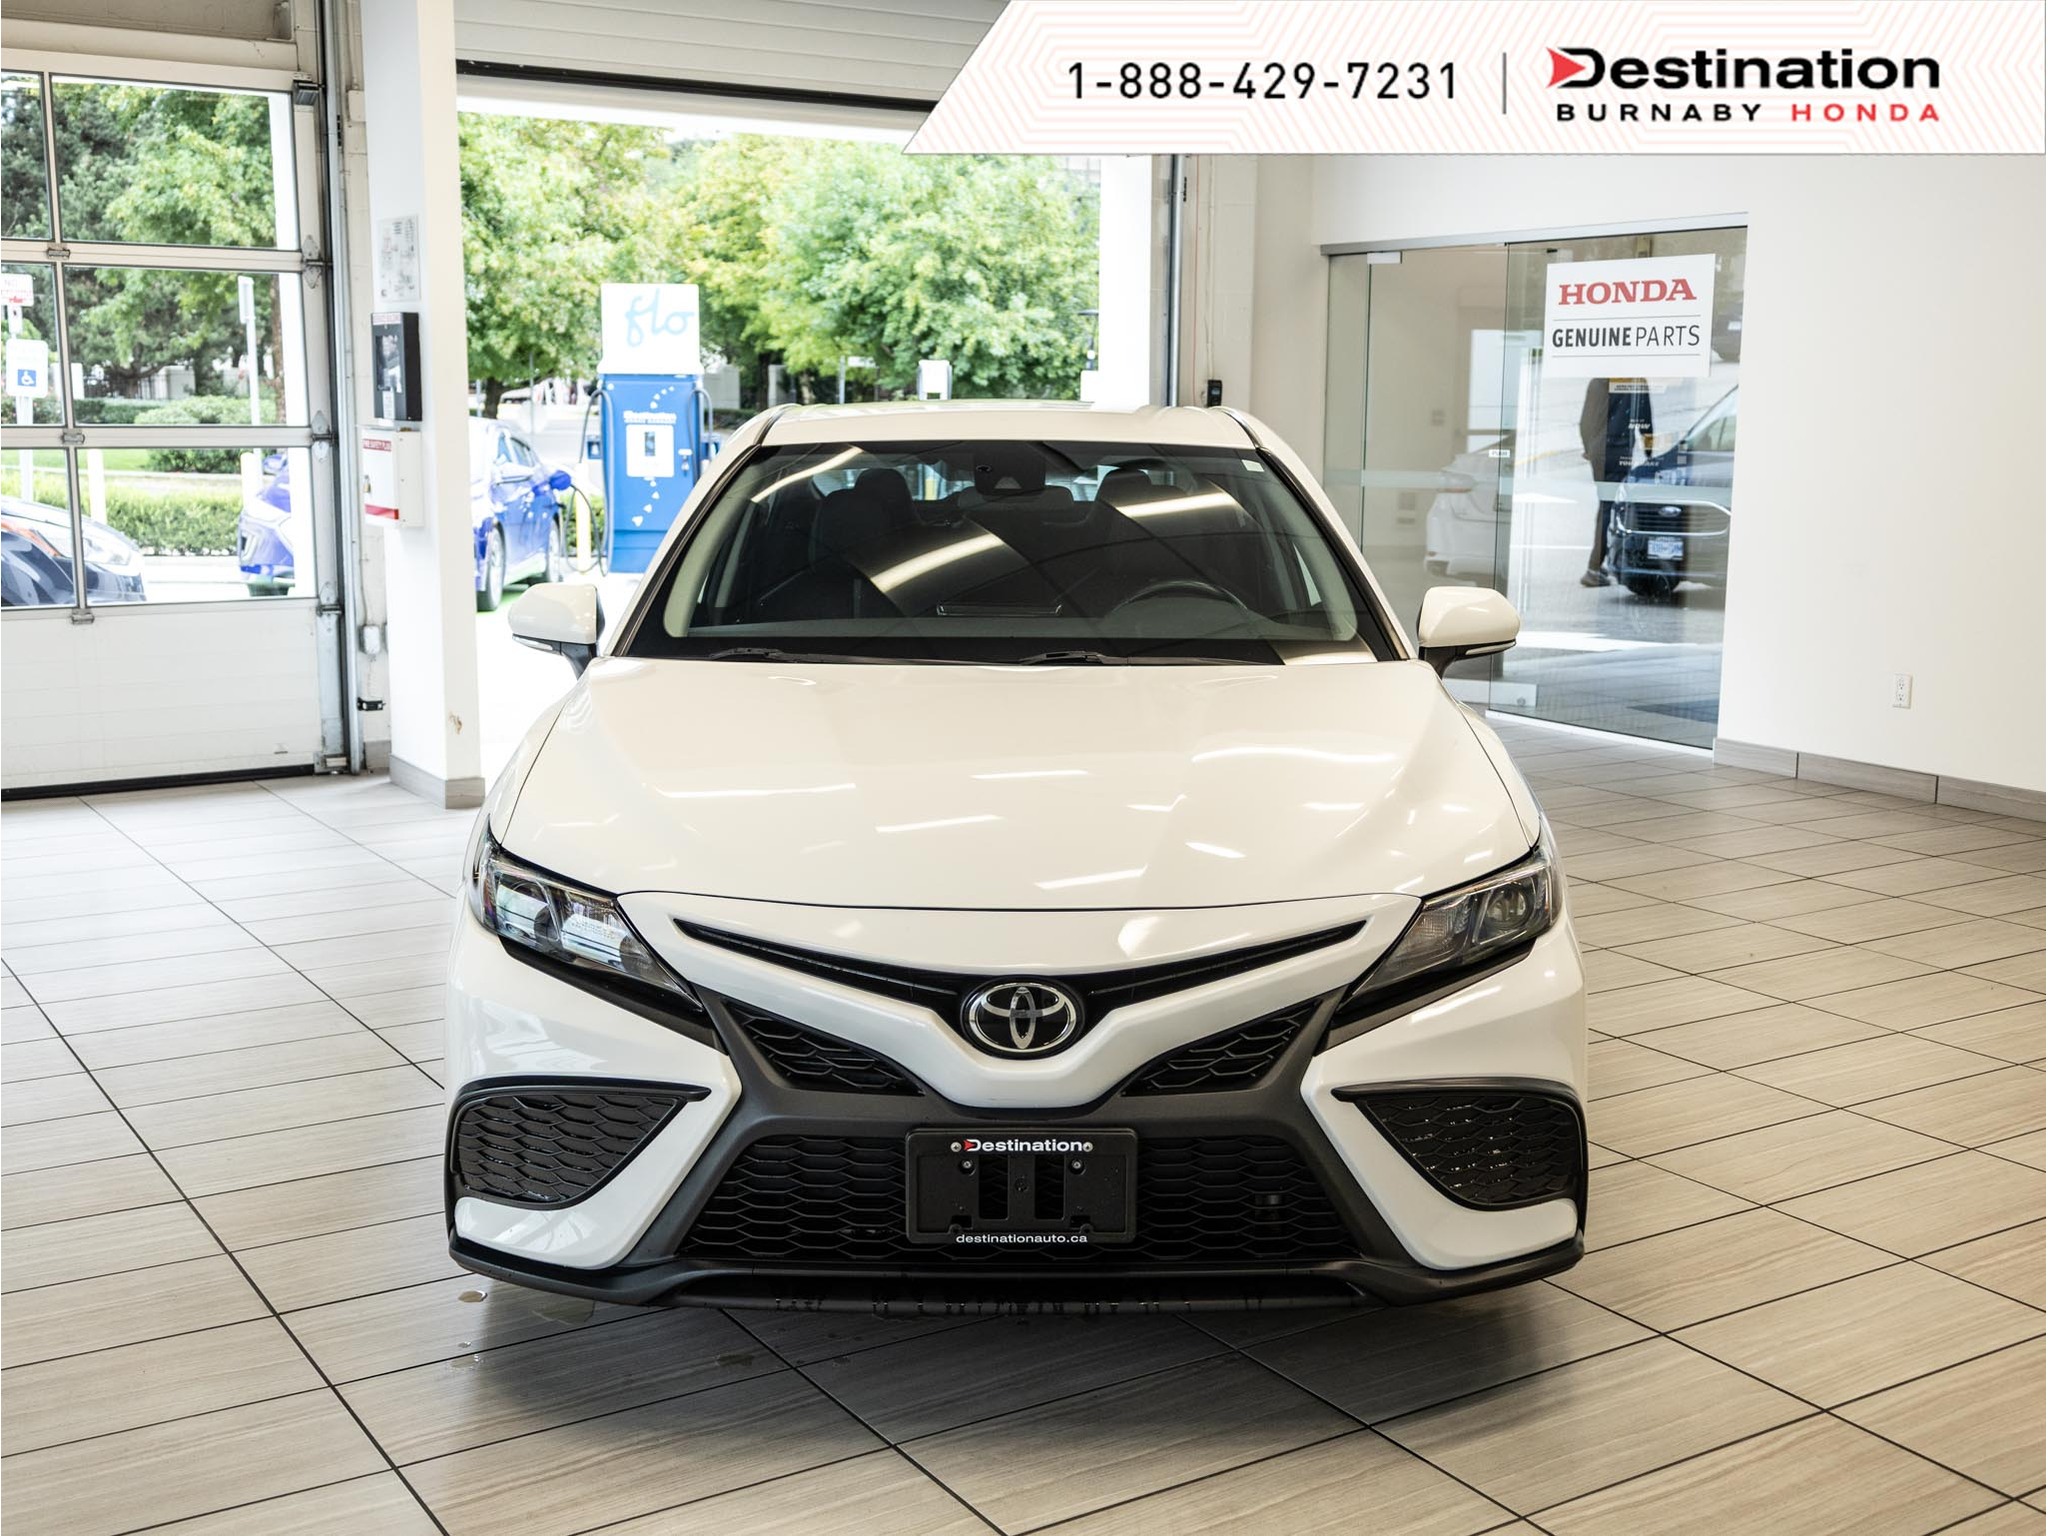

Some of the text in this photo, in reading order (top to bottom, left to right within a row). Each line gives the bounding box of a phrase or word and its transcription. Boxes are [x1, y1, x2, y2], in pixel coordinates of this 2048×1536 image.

[1558, 278, 1696, 305] HONDA
[625, 288, 695, 347] flo
[1552, 325, 1700, 348] GENUINE PARTS
[964, 1138, 1083, 1152] Destination
[955, 1233, 1088, 1243] destinationauto.ca
